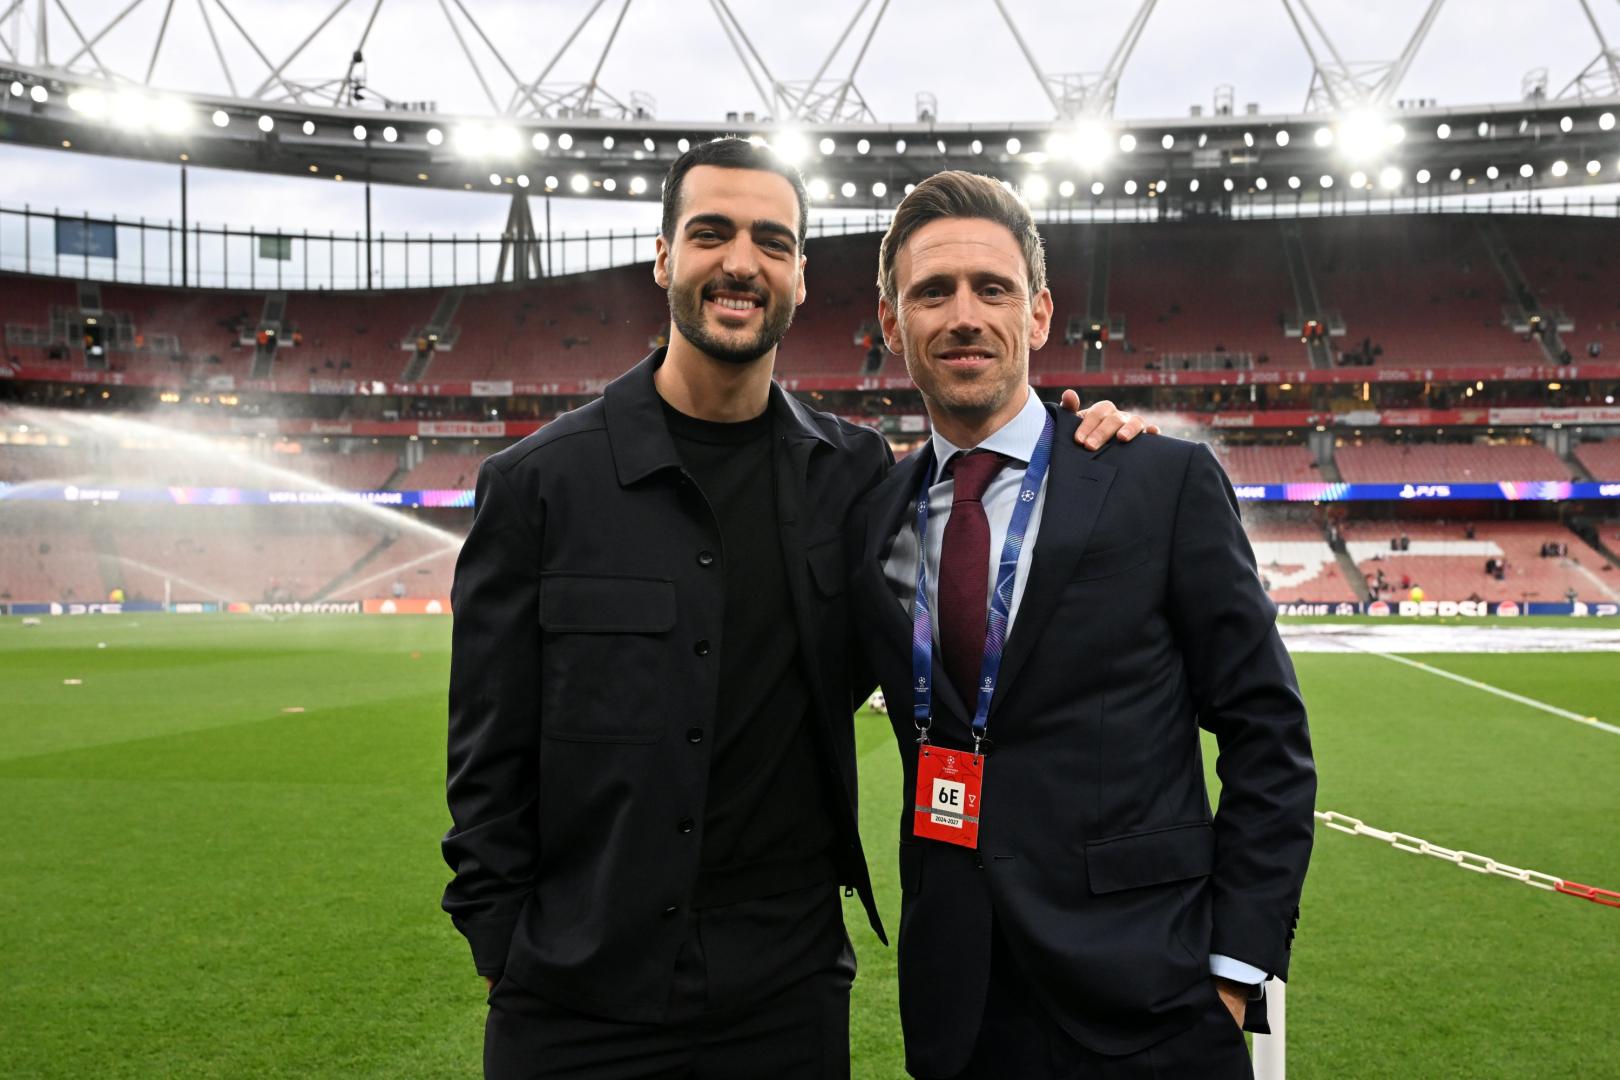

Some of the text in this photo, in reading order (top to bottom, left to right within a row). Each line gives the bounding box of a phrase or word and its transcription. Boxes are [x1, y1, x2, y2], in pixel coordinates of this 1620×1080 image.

[254, 602, 359, 614] mastercard
[1278, 604, 1328, 616] EAGUE
[939, 787, 959, 806] 6E
